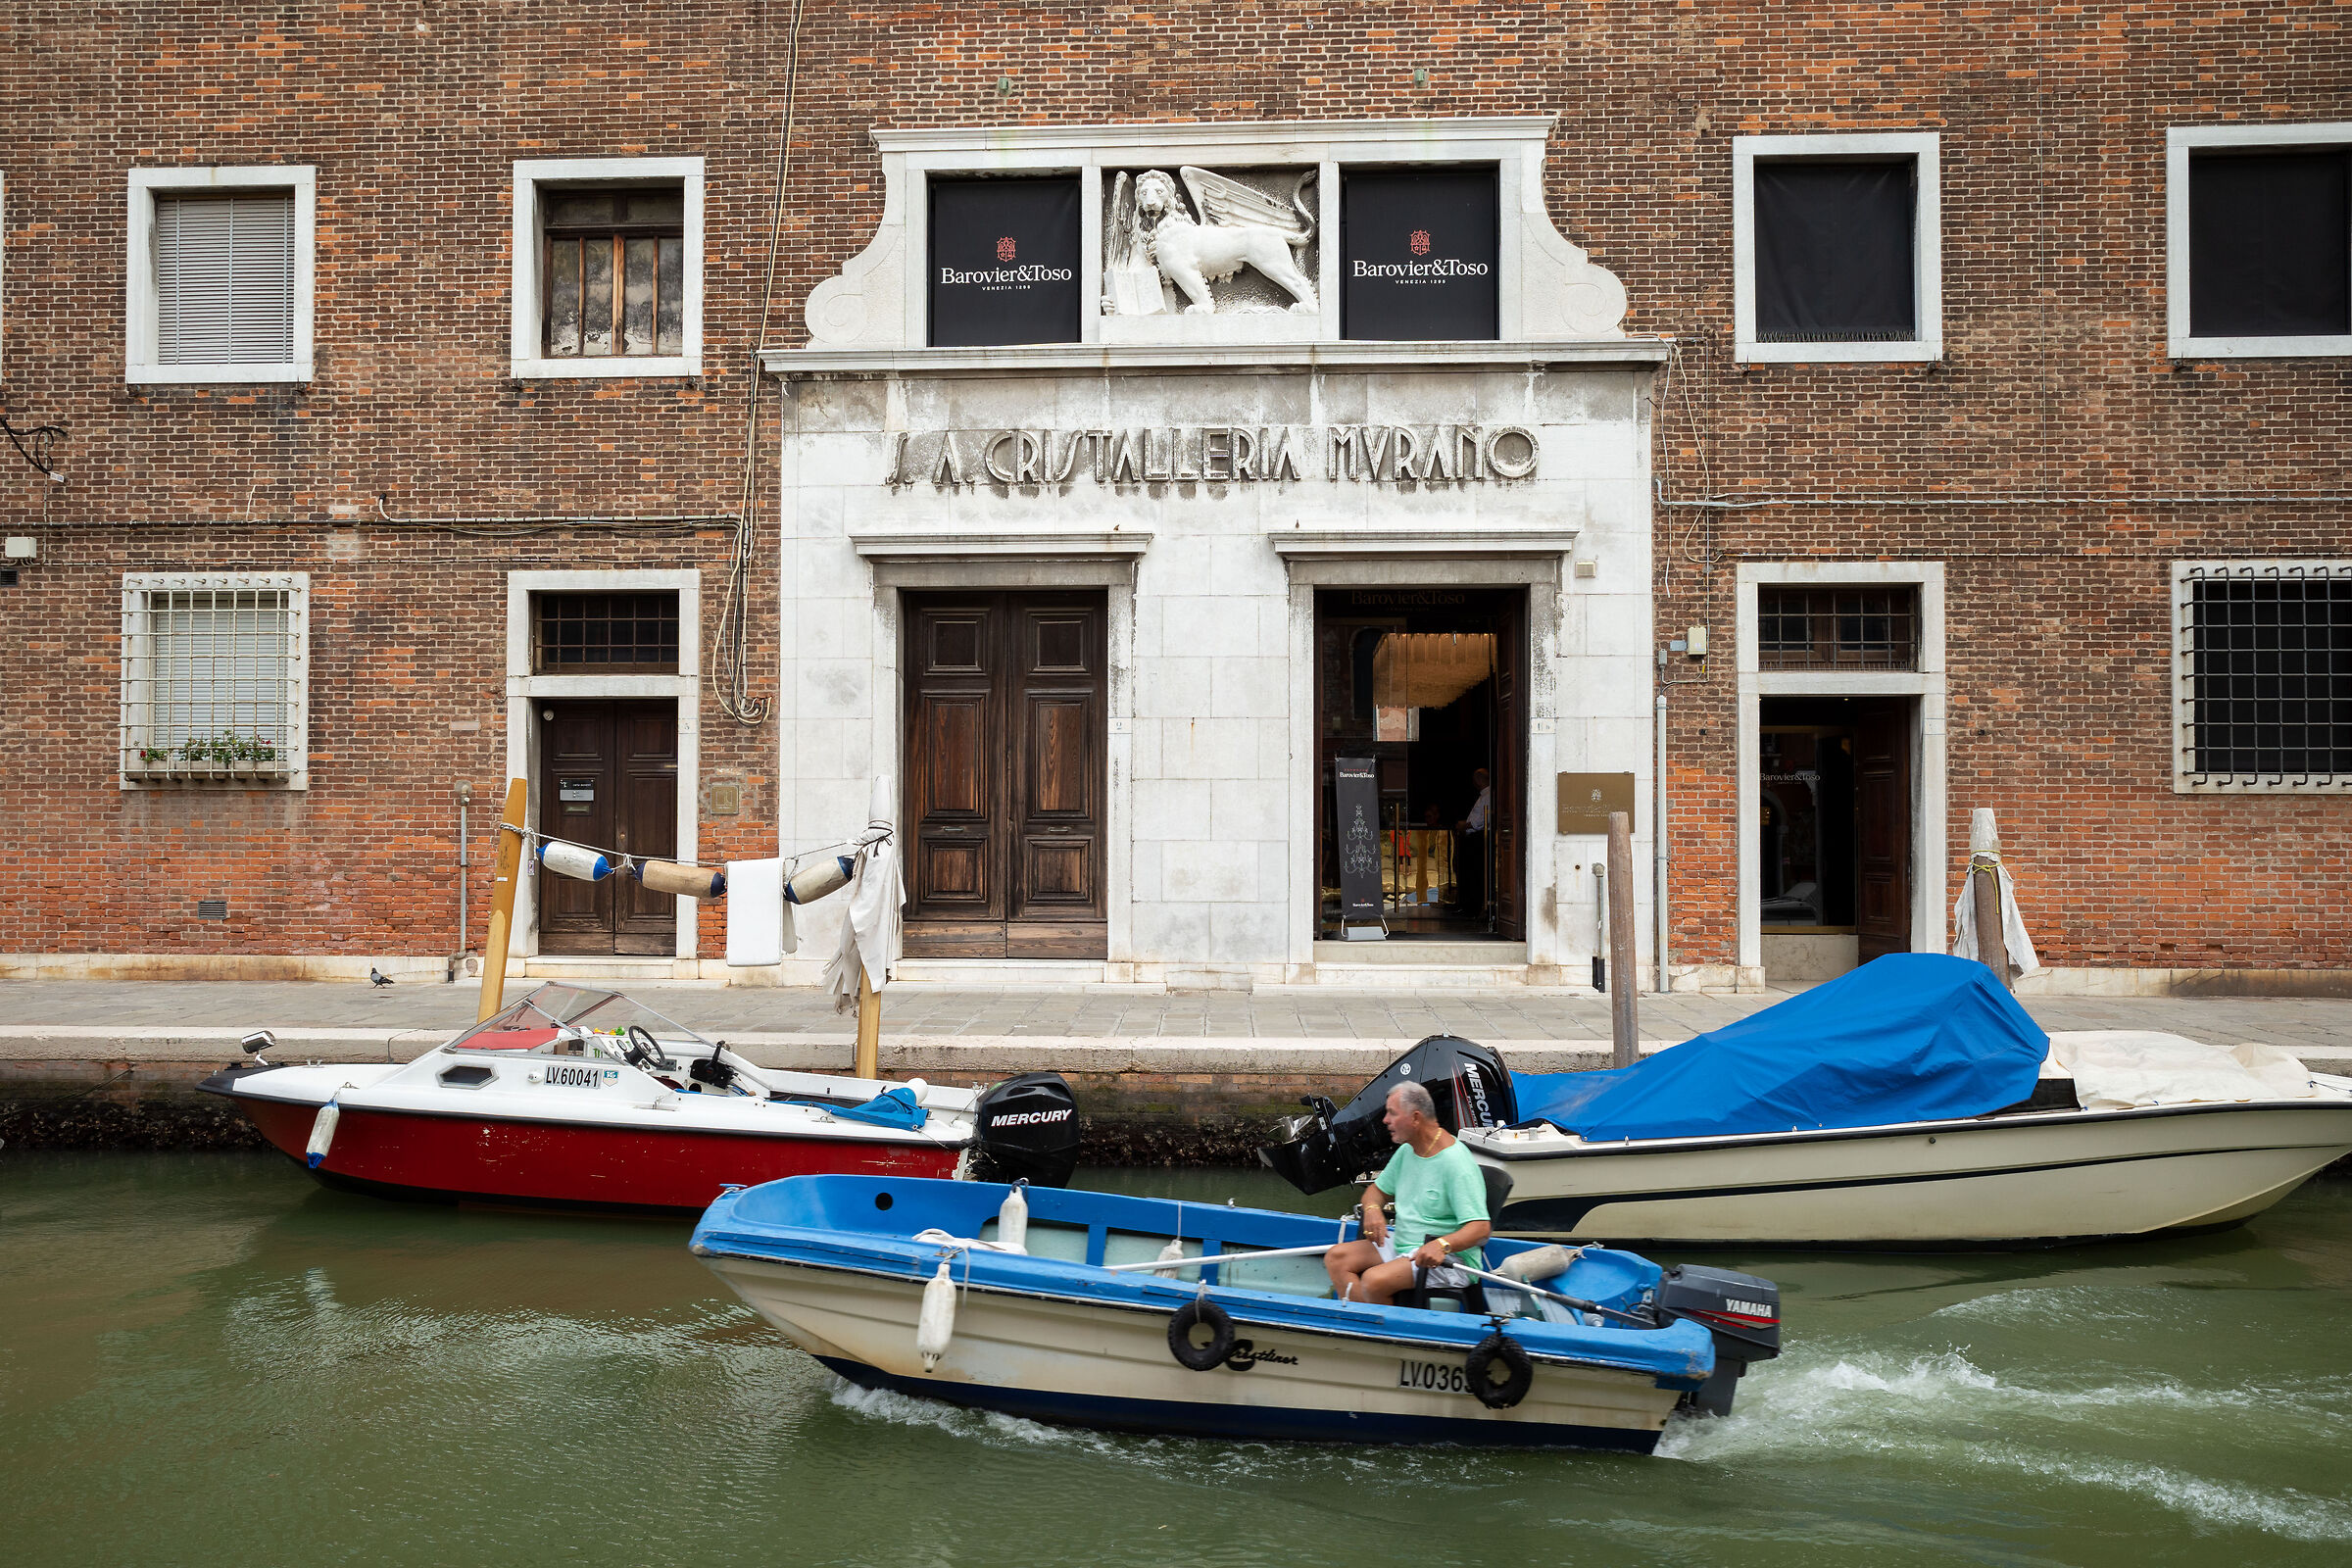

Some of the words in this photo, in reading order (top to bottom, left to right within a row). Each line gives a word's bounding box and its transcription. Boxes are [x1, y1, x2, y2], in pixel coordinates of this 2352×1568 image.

[941, 265, 1072, 284] Barovier&Toso
[1352, 259, 1489, 277] Barovier&Toso
[984, 426, 1301, 483] CRISTALLERIA
[1350, 589, 1466, 605] Barovier&Toso
[1759, 772, 1821, 781] Barovier&Toso
[1464, 1062, 1494, 1127] MERCU
[991, 1108, 1072, 1127] MERCURY
[1726, 1298, 1772, 1318] YAMAHA
